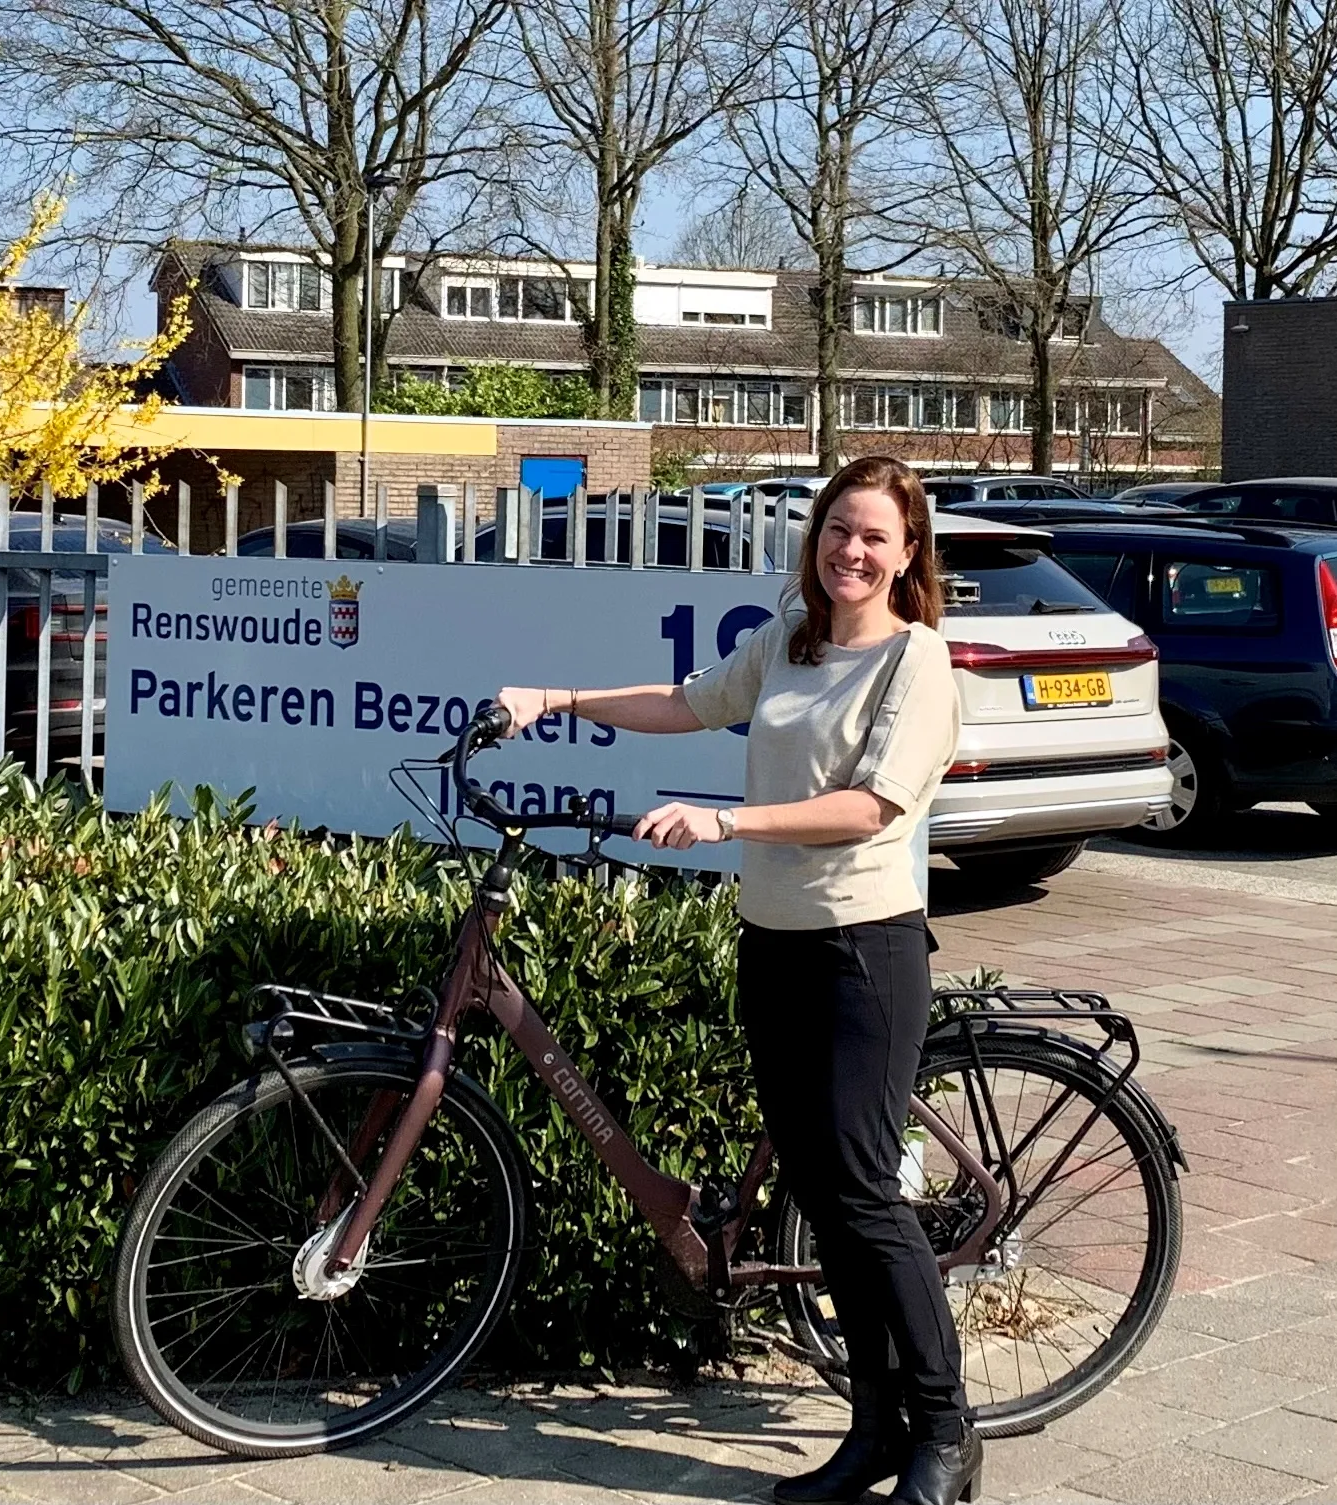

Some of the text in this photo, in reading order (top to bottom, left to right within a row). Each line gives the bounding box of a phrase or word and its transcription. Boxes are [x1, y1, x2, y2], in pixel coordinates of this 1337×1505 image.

[212, 576, 323, 601] gemeente
[132, 602, 322, 646] Renswoude
[130, 668, 617, 747] Parkeren Bezoers
[1038, 678, 1106, 699] H-934-GB
[552, 1067, 614, 1145] CORTINA
